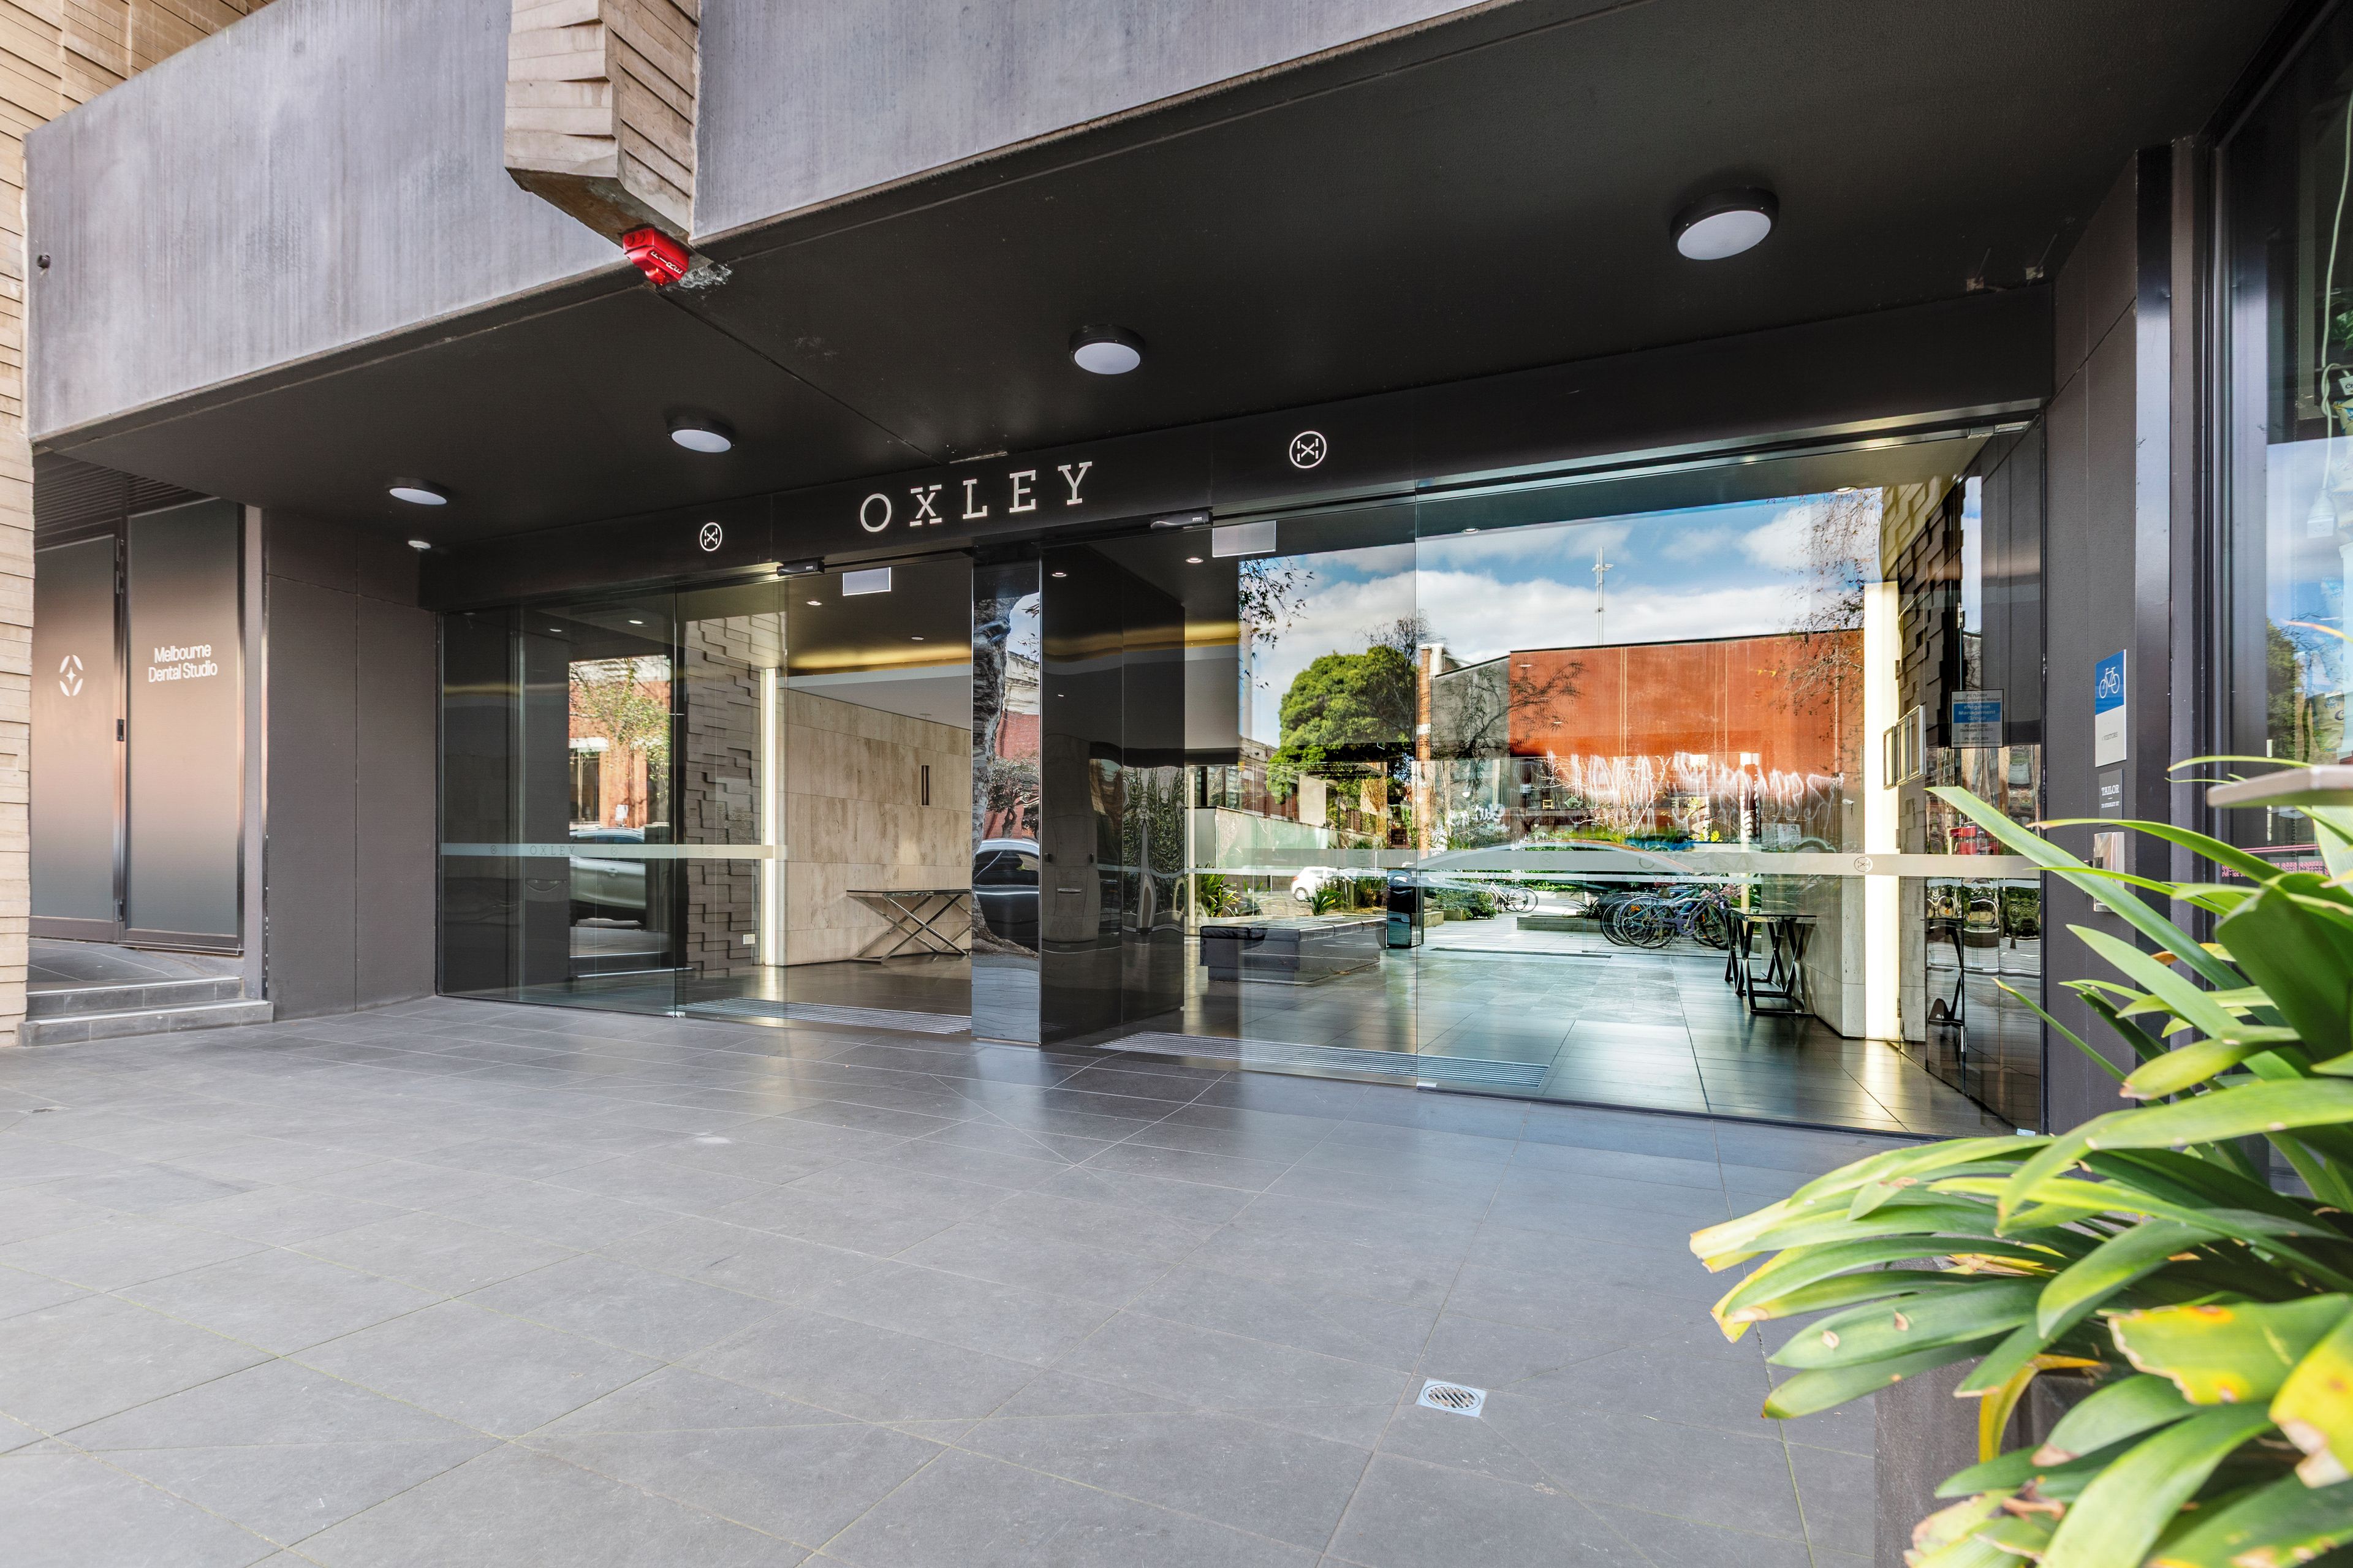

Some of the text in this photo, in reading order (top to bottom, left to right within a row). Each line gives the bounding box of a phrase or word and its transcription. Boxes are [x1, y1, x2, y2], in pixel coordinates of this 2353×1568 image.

[650, 251, 683, 274] FIRE
[860, 461, 1092, 532] OXLEY
[154, 644, 211, 663] Melbourne
[148, 660, 218, 683] Dental Studio
[2101, 784, 2120, 796] TAILOR
[530, 845, 575, 855] OXLEY
